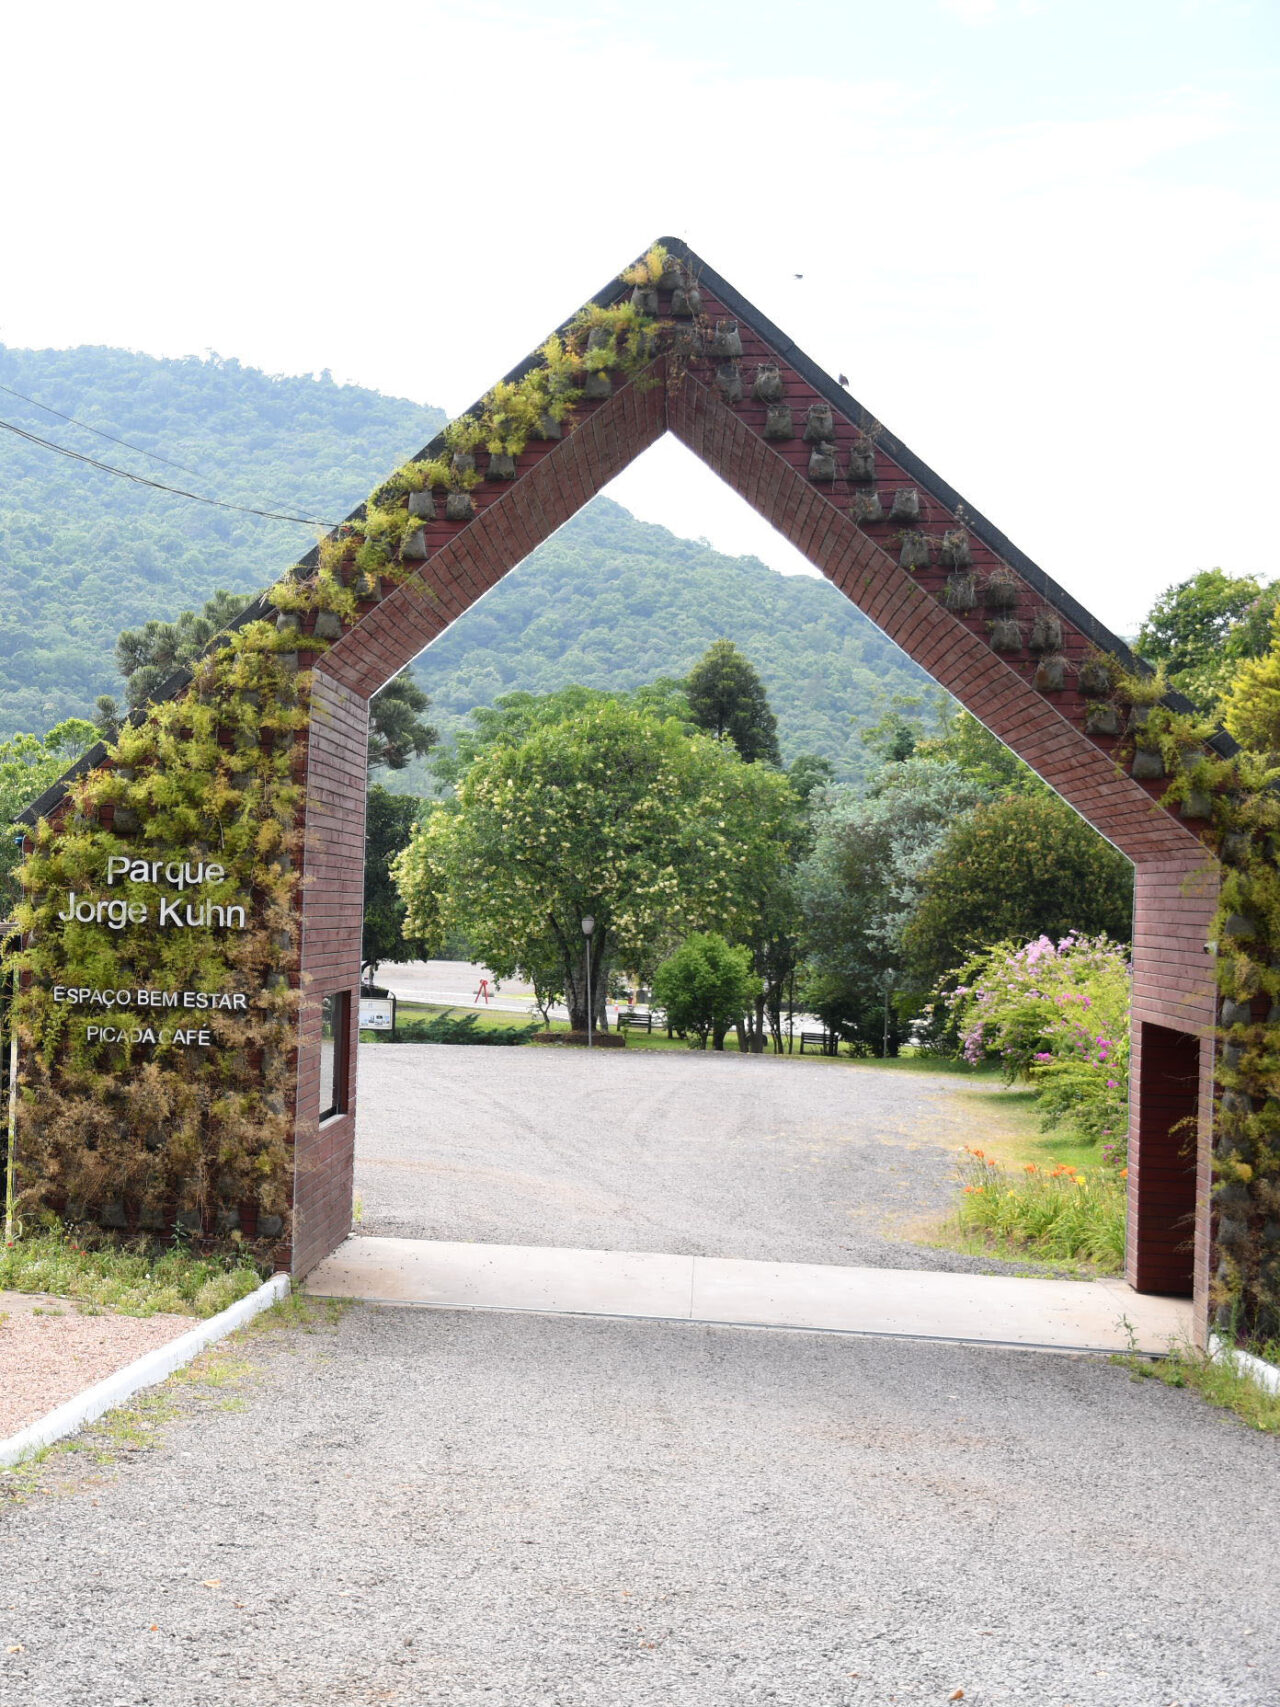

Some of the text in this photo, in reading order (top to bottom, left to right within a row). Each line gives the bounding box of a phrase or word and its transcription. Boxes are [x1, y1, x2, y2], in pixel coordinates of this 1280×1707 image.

[107, 856, 225, 890] Parque
[58, 892, 245, 929] Jorge Kuhn
[53, 986, 247, 1009] ESPAÇO BEM ESTAR
[86, 1023, 211, 1046] PICADA CAFÉ
